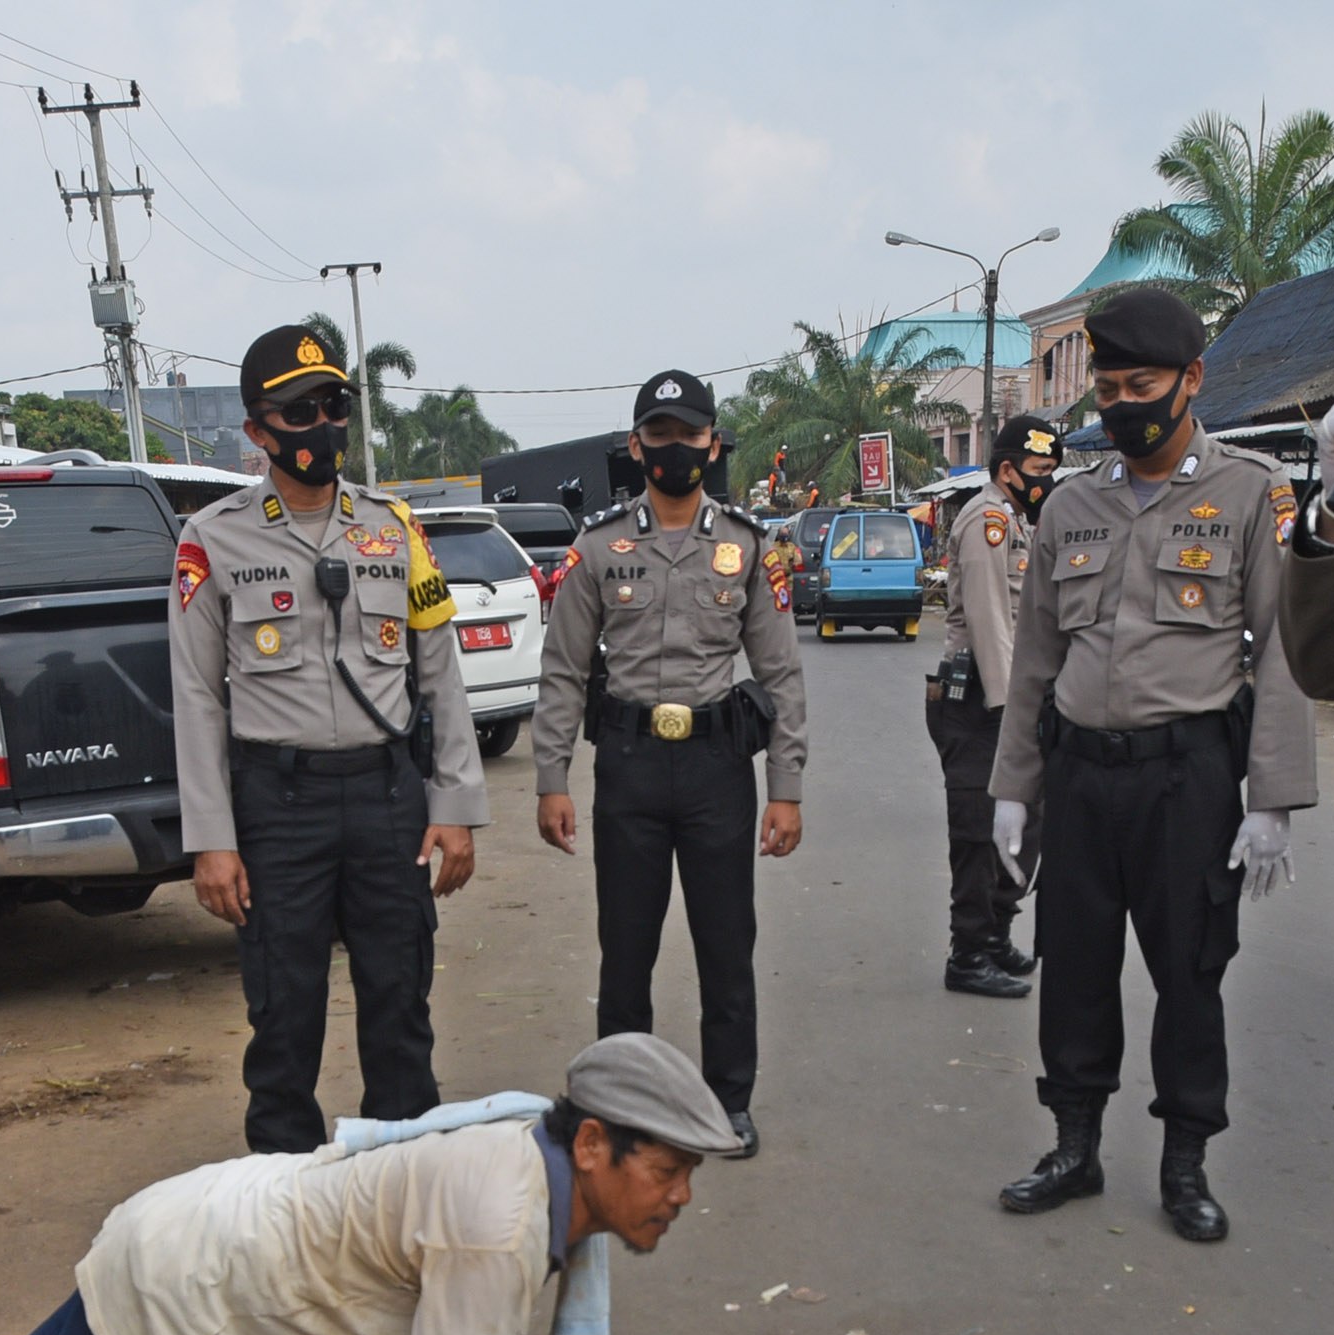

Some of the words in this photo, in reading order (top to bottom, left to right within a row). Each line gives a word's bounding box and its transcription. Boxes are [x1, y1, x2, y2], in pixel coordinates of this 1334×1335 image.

[1172, 523, 1229, 538] POLRI
[231, 565, 290, 586] YUDHA
[355, 564, 406, 580] POLRI
[604, 567, 647, 580] ALIF
[25, 743, 120, 768] NAVARA
